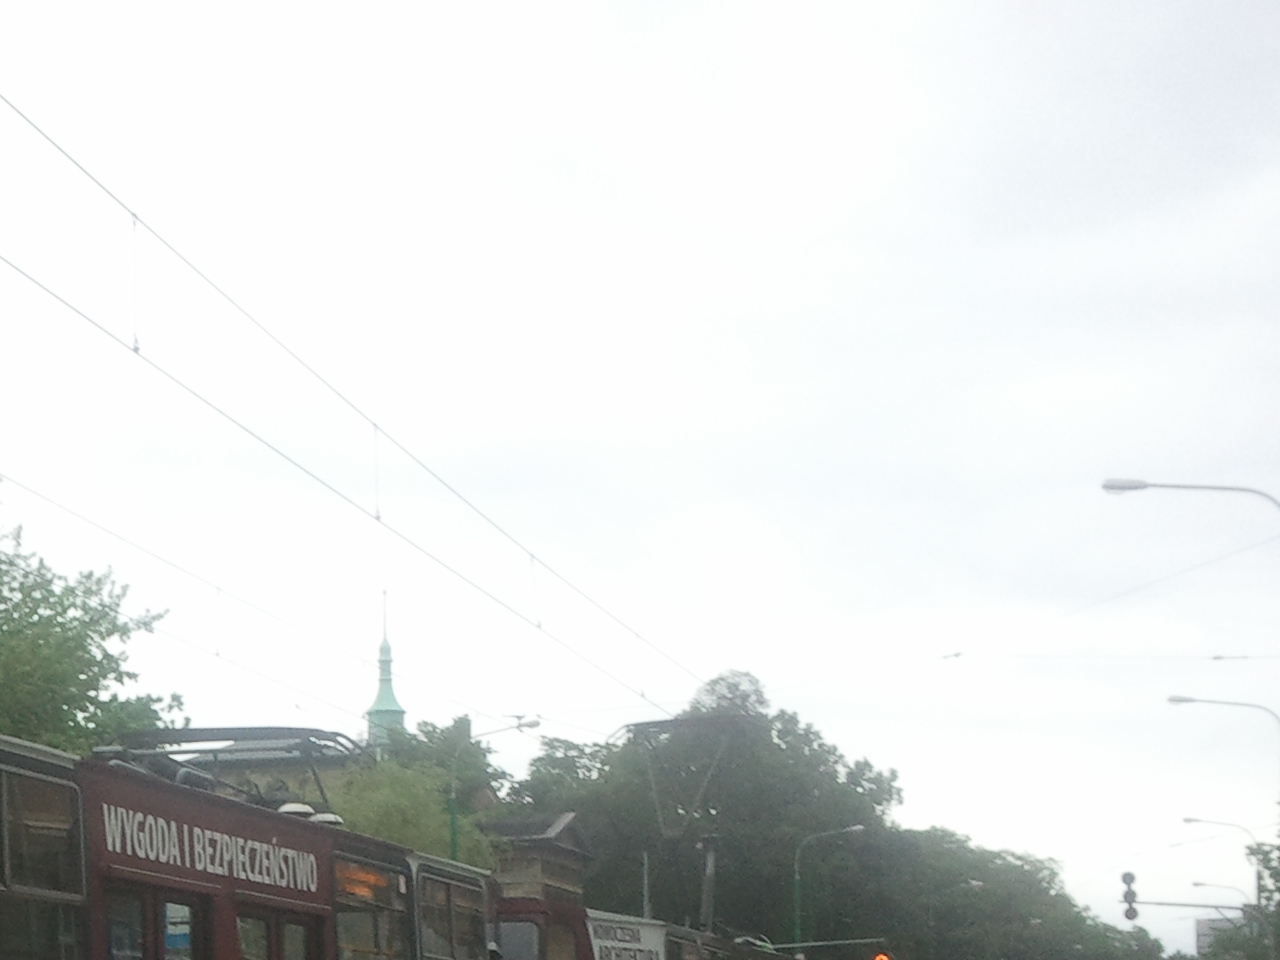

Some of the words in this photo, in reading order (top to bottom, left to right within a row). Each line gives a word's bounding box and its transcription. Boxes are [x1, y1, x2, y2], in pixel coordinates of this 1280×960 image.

[102, 802, 181, 868] WYGODA
[183, 824, 190, 868] I
[193, 826, 318, 893] BEZPIECZEŃSTWO
